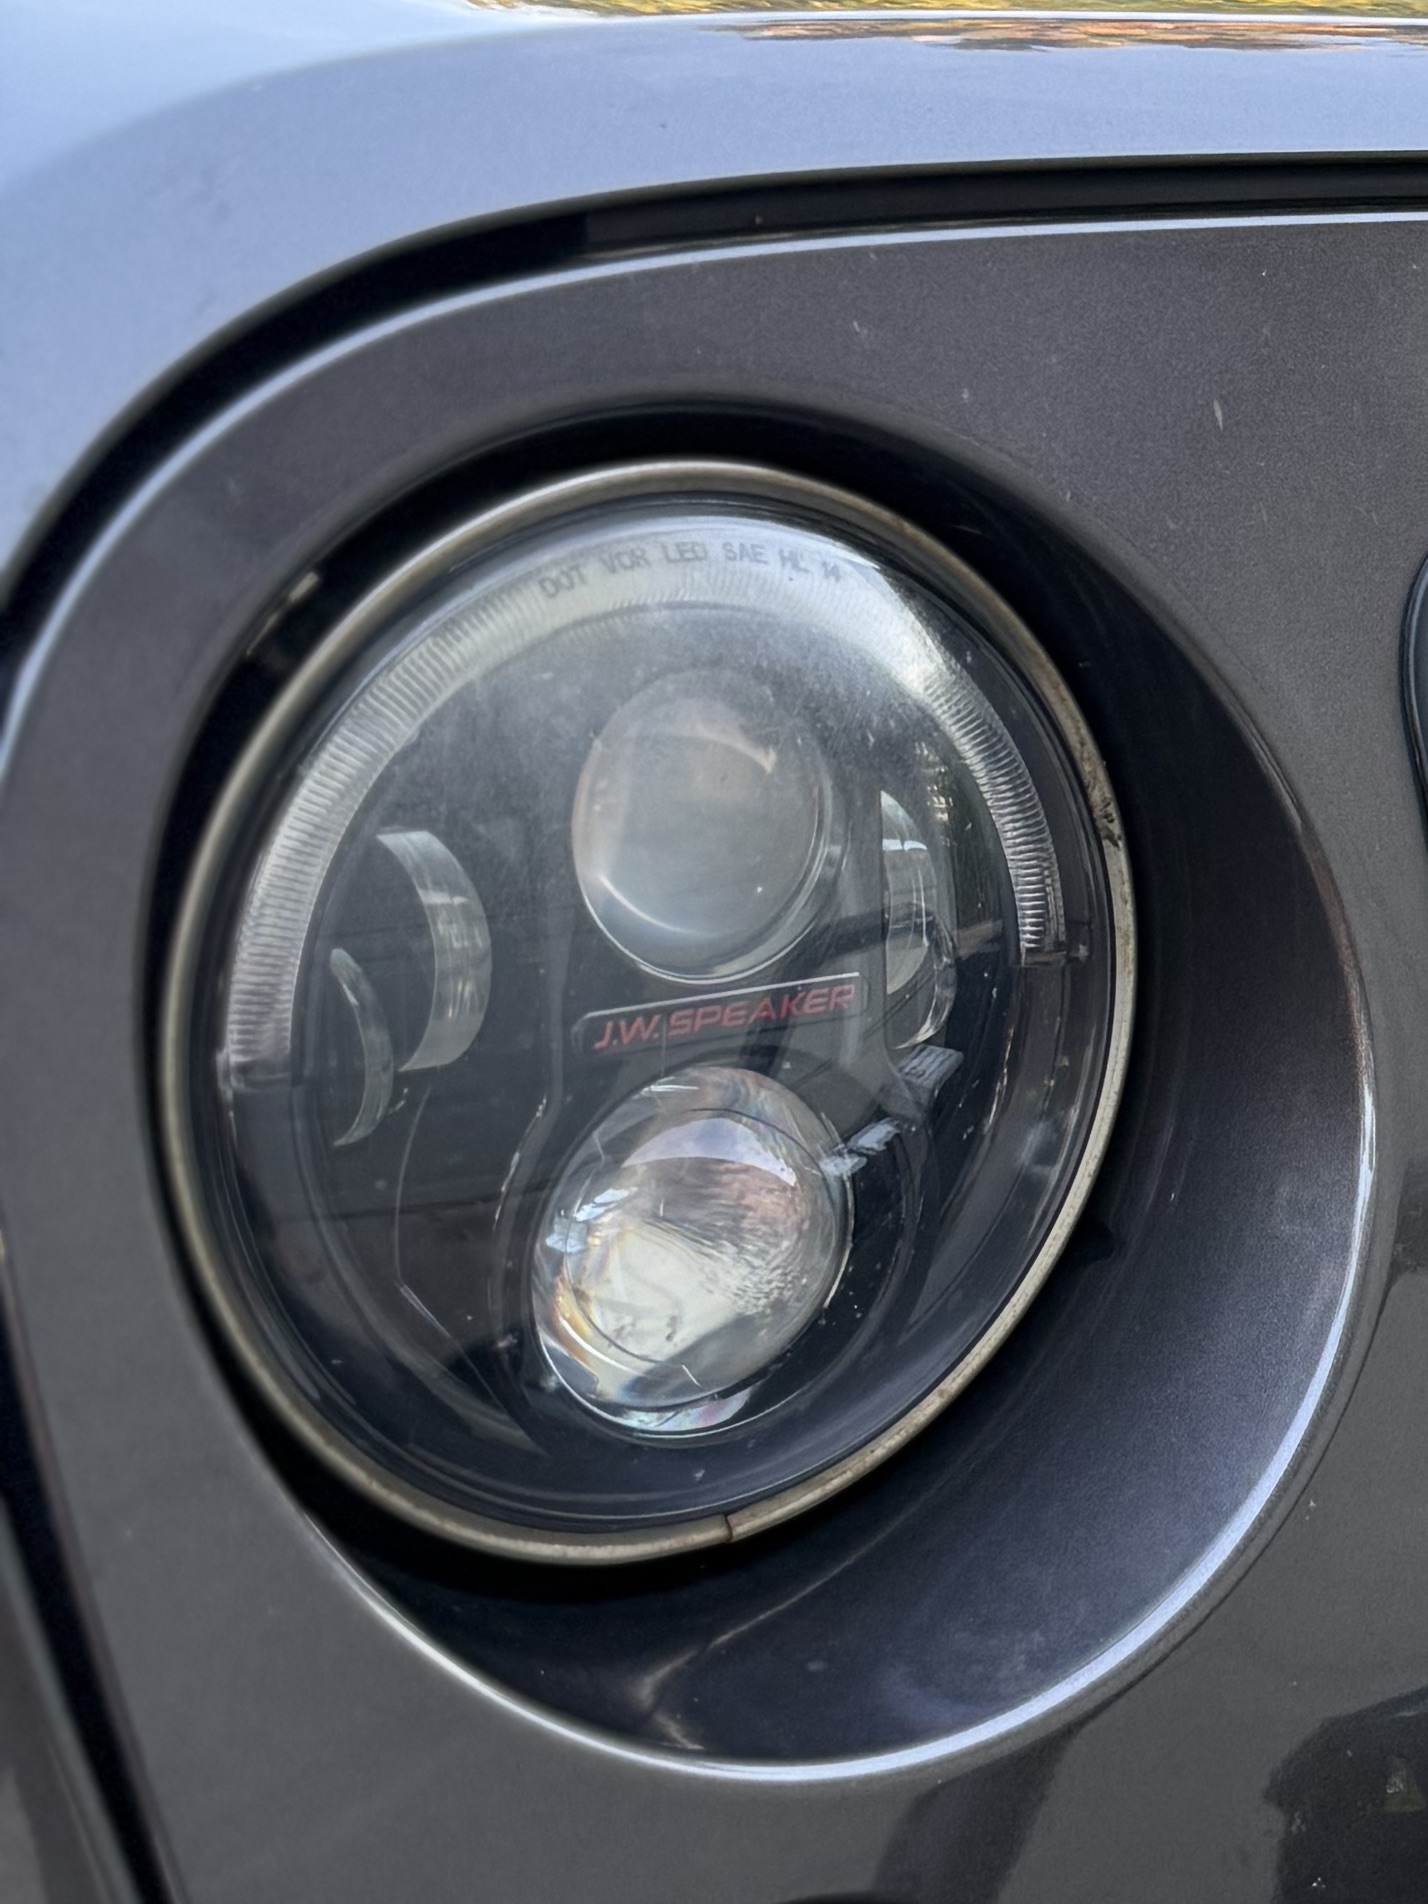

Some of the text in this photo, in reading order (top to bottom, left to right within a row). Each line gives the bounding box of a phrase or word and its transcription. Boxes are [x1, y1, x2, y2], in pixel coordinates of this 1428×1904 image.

[538, 564, 589, 597] DOT
[662, 541, 707, 563] LED
[725, 542, 768, 565] SAE
